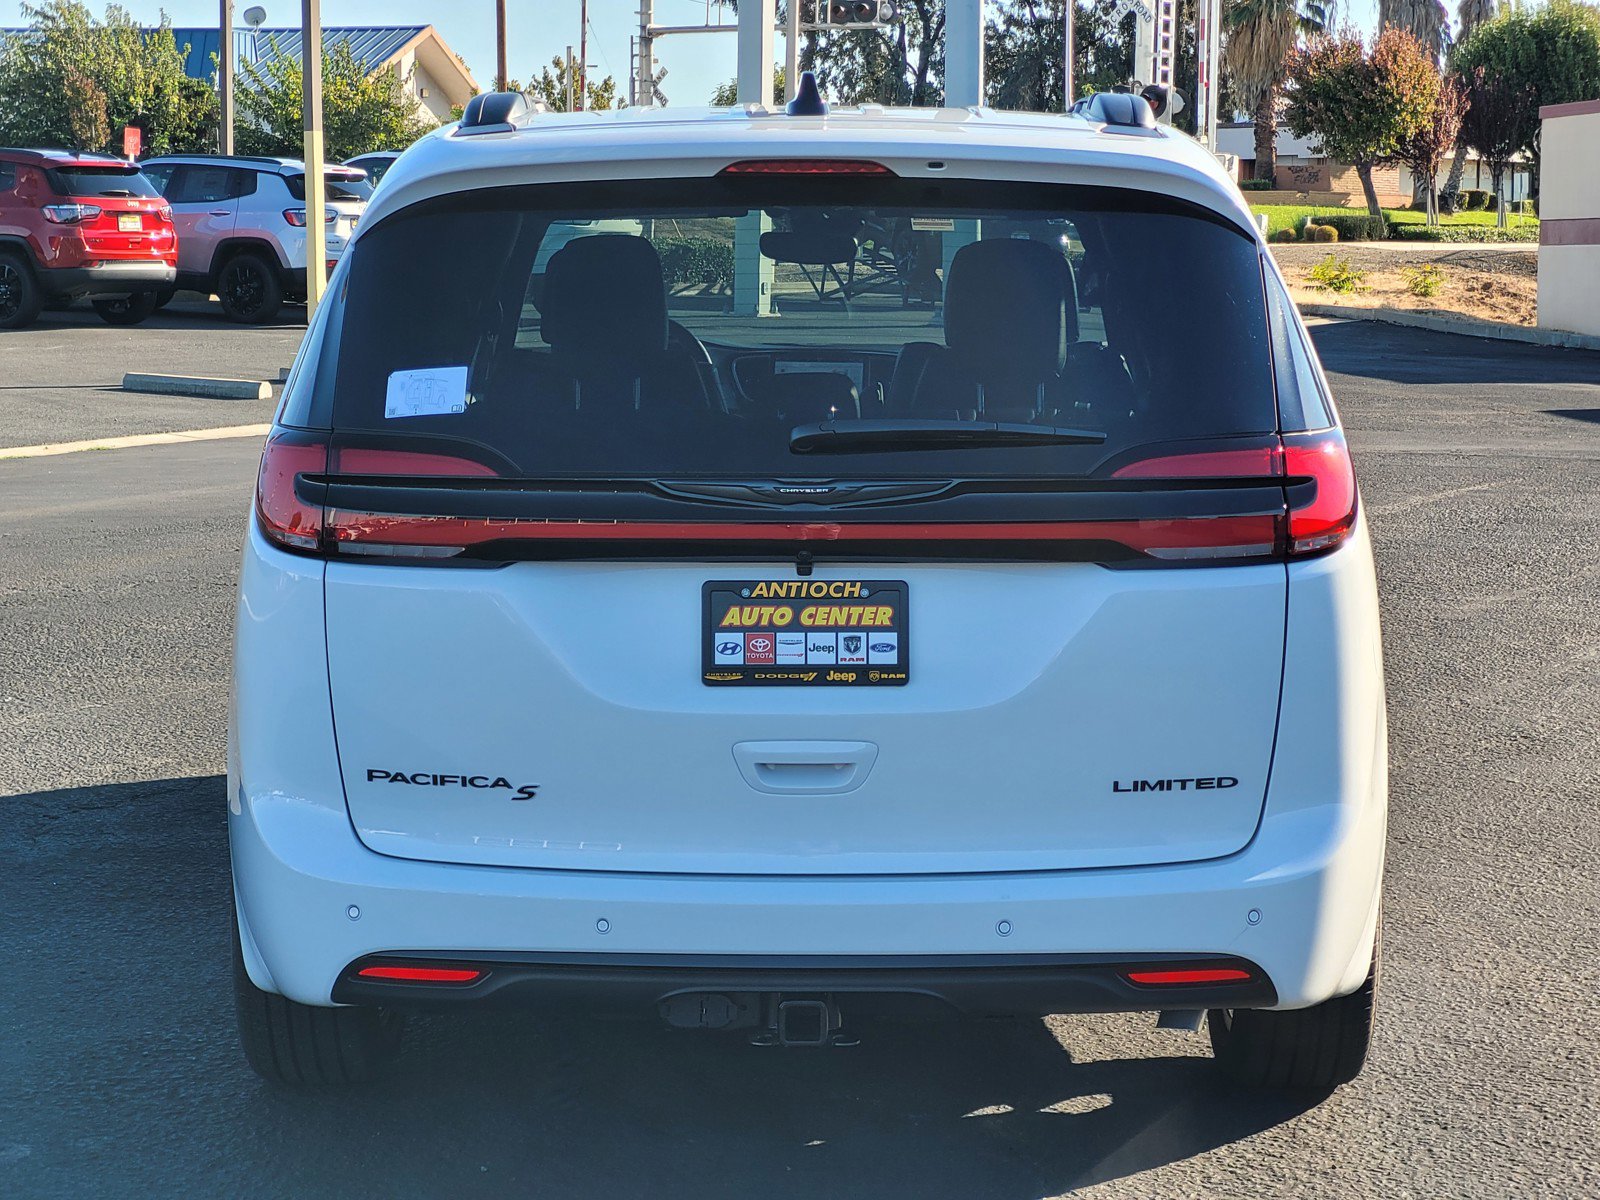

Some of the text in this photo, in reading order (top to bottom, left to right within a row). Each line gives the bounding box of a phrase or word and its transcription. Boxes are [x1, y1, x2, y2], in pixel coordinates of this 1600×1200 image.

[1134, 1, 1151, 23] ROAD
[751, 582, 861, 598] ANTIOCH
[719, 605, 894, 627] AUTO CENTER
[808, 643, 835, 654] Jeep
[826, 670, 857, 683] Jeep
[367, 769, 540, 801] PACIFICA S
[1113, 776, 1239, 793] LIMITED
